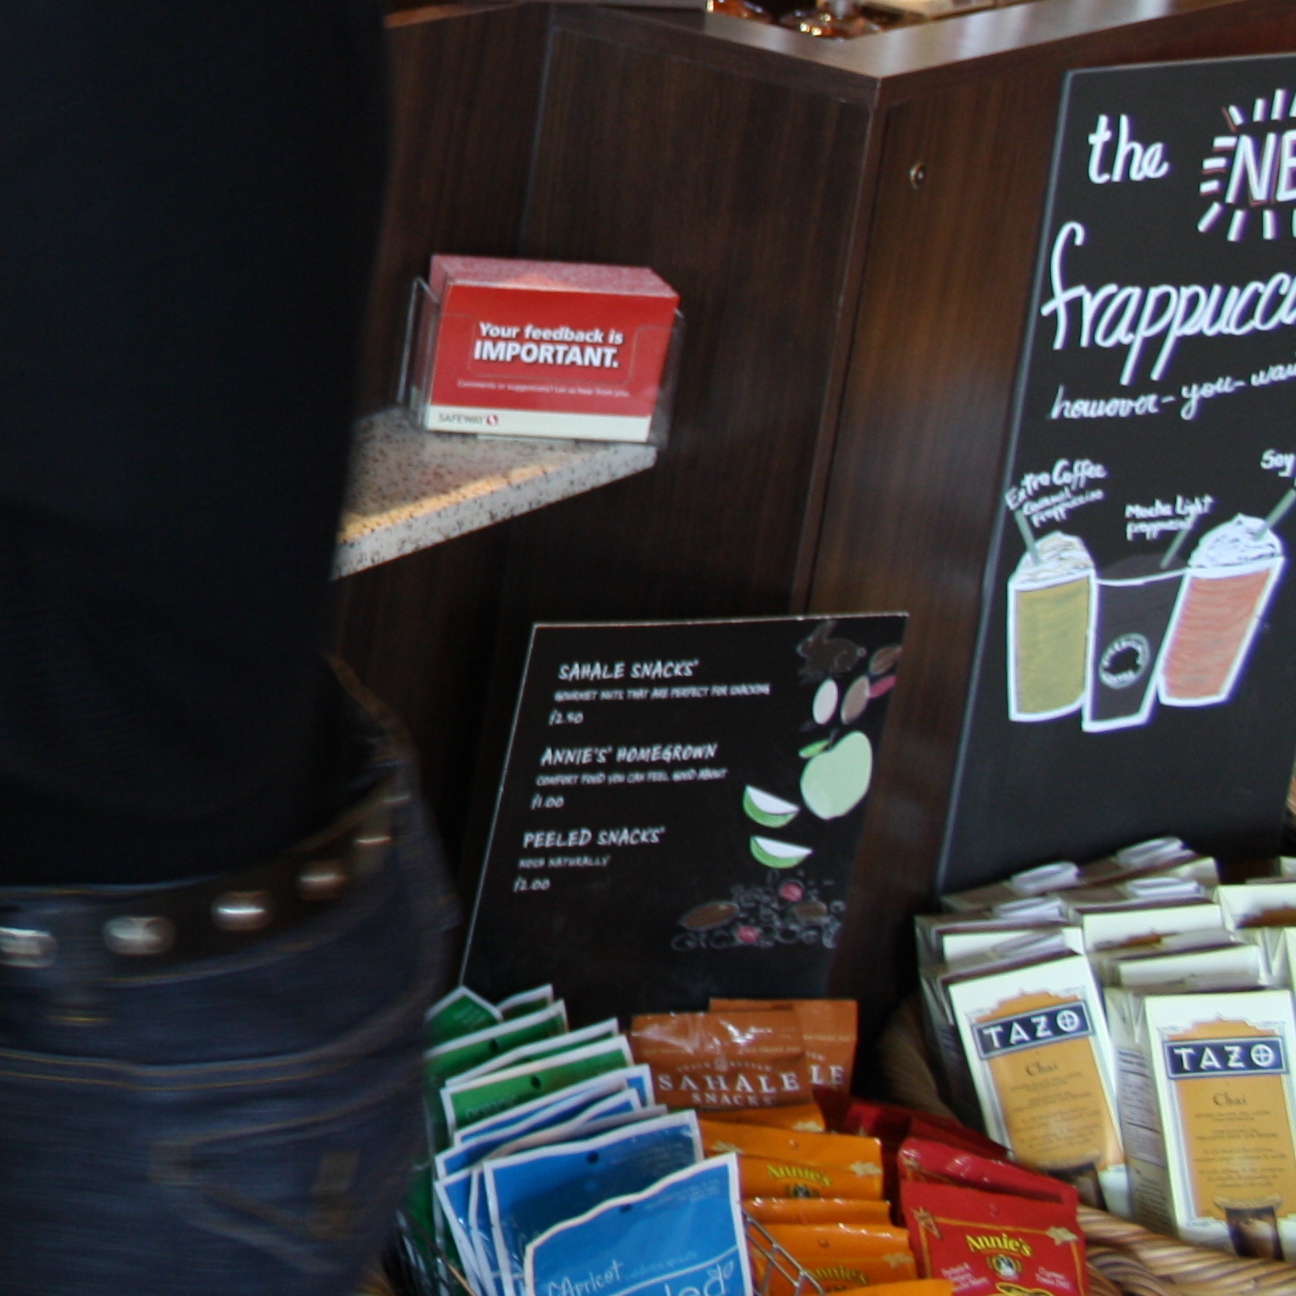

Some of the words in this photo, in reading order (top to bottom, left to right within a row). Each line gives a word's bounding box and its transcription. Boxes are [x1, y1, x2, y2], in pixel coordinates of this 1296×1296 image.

[1088, 112, 1171, 184] the
[479, 321, 520, 340] Your
[523, 324, 604, 345] feedback
[608, 329, 624, 345] is
[473, 339, 620, 369] IMPORTANT.
[1051, 459, 1108, 491] Coffee
[1260, 449, 1295, 478] Soy
[557, 660, 625, 683] SAHALE
[630, 658, 700, 680] SNACKS
[539, 744, 613, 767] ANNIE'S
[615, 741, 720, 765] HOMEGROWN
[522, 826, 593, 849] PEELED
[596, 825, 667, 848] SNACKS
[547, 854, 611, 869] NATURALLY
[981, 1008, 1081, 1049] TAZO
[1024, 1060, 1058, 1077] Chai
[1173, 1043, 1276, 1071] TAZO
[656, 1071, 801, 1095] SAHALE
[1212, 1092, 1248, 1107] Chai
[766, 1163, 833, 1188] Annie's
[964, 1232, 1033, 1257] Annie's
